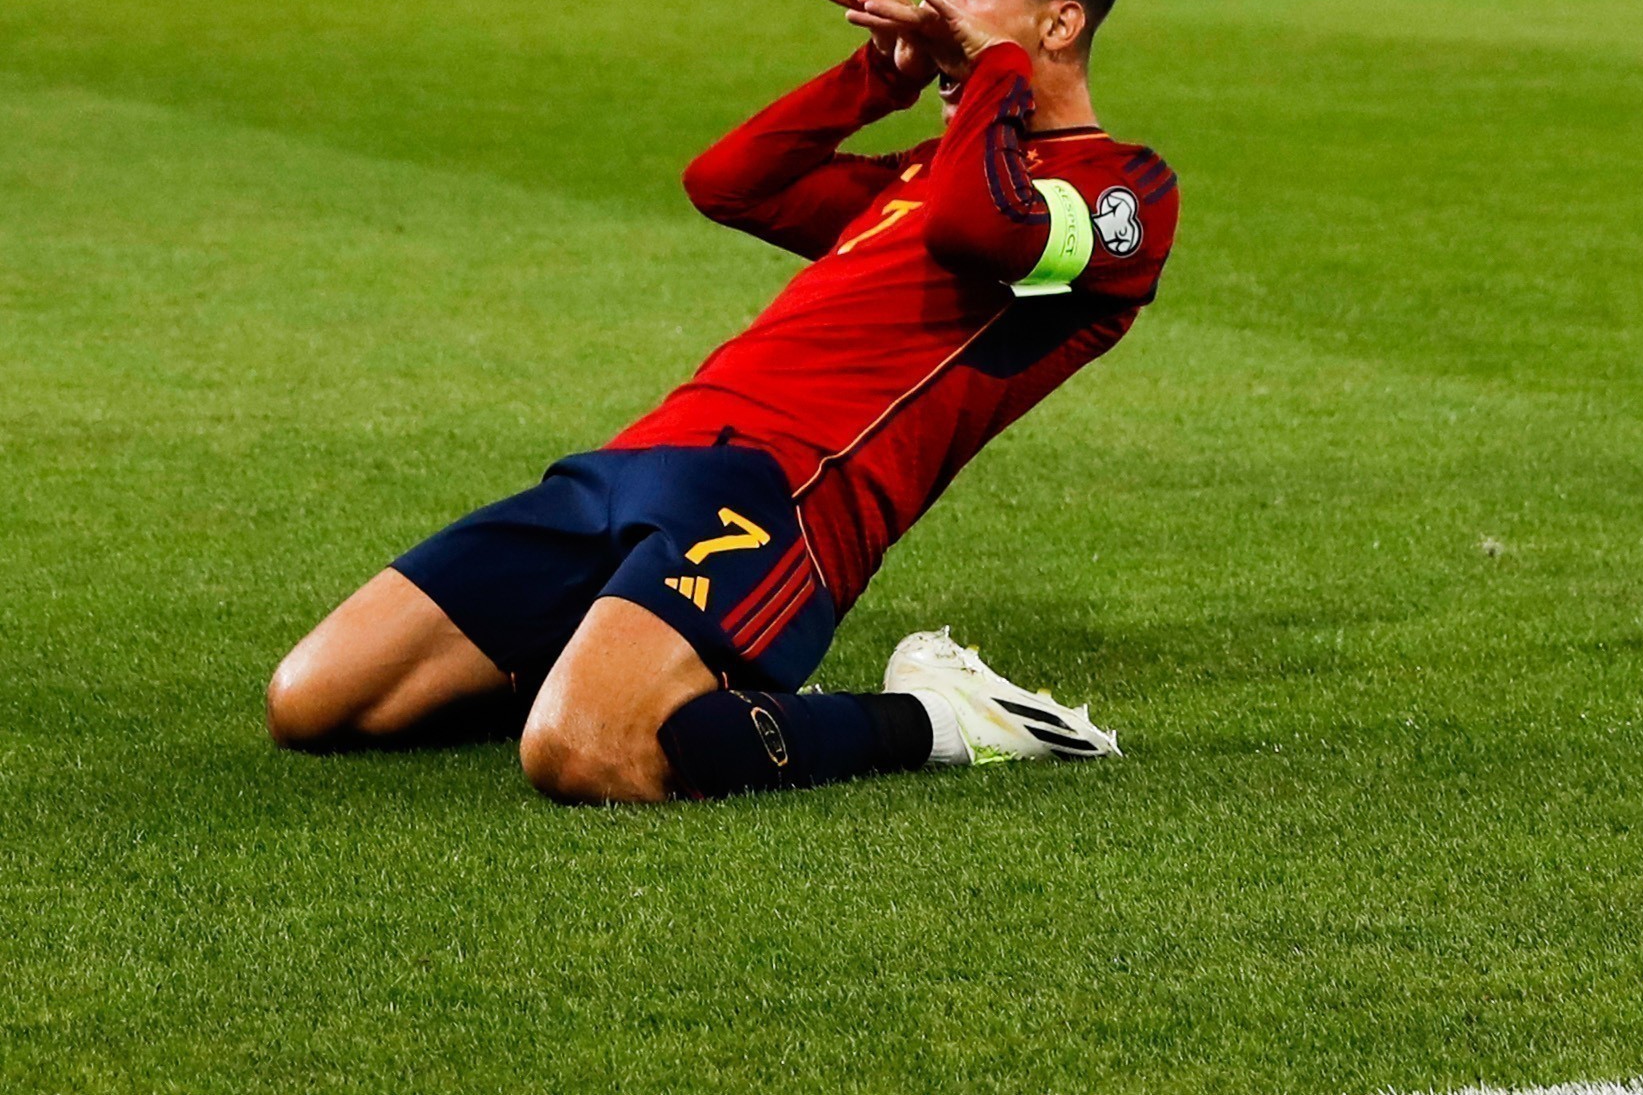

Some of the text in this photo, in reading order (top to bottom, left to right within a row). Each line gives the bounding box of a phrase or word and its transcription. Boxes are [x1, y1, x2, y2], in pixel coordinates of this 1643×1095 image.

[837, 198, 924, 255] 7
[1053, 184, 1077, 257] RESPECT
[684, 506, 771, 565] 7
